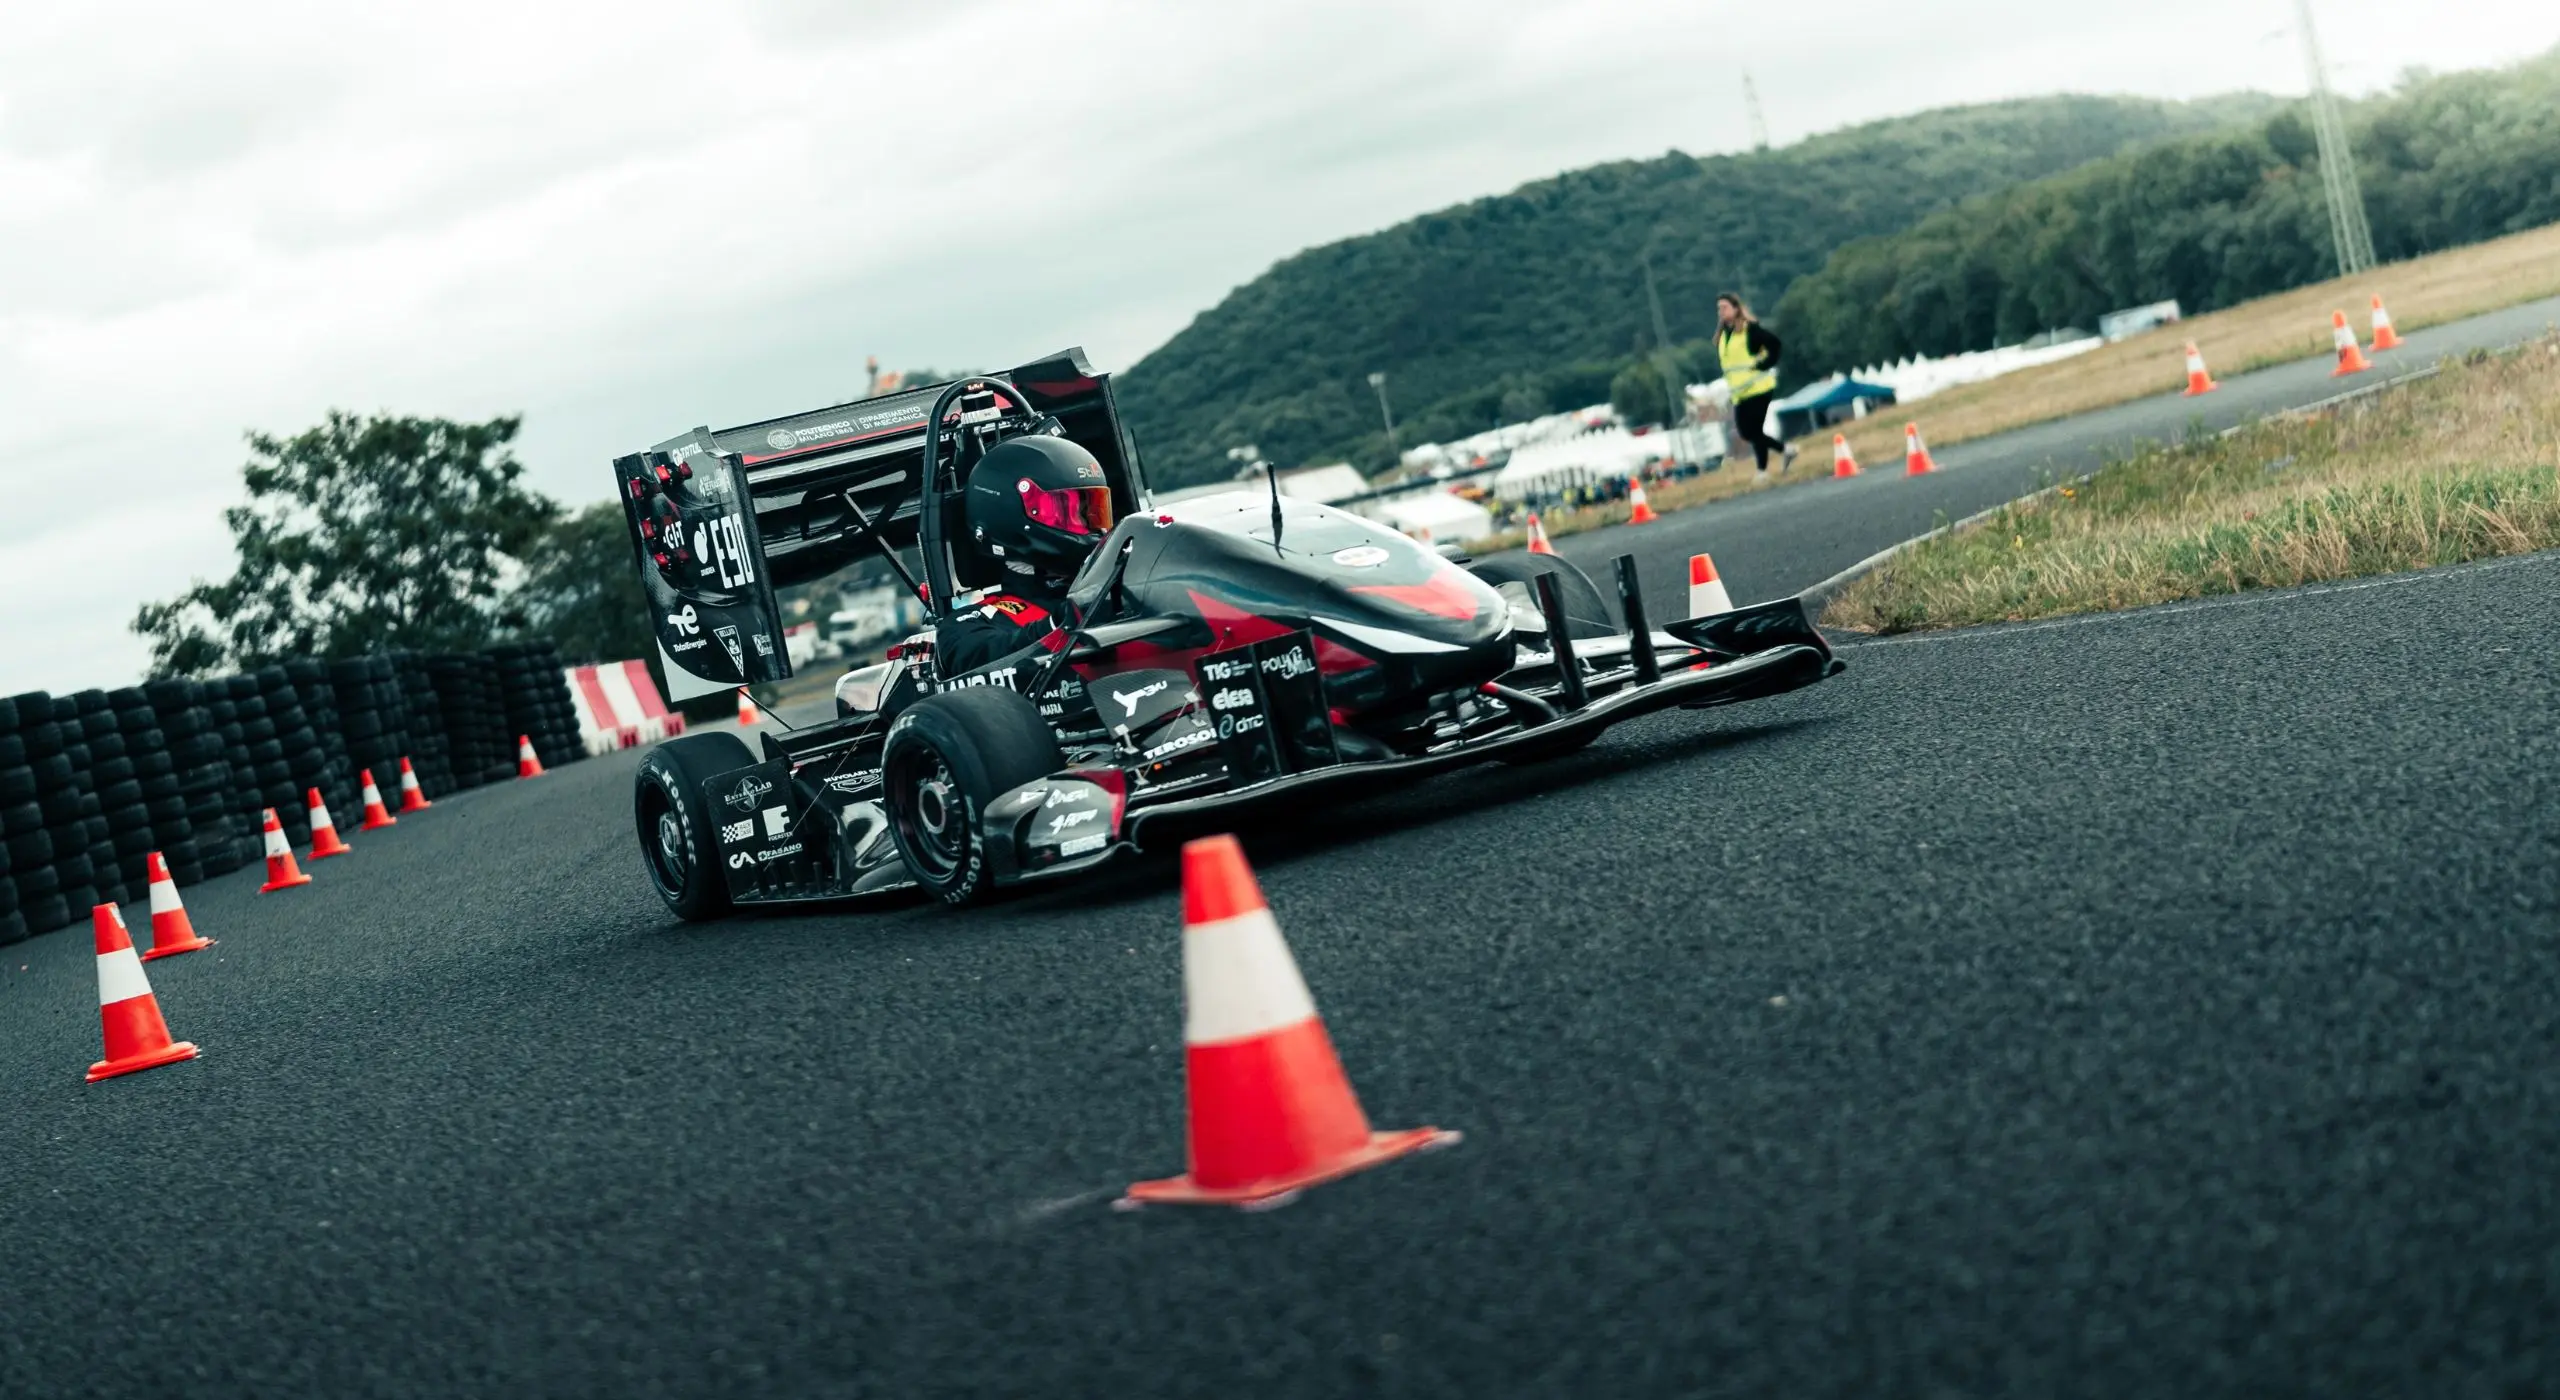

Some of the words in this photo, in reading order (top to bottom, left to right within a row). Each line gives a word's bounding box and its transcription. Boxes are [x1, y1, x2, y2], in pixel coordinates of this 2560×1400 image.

[858, 406, 921, 424] DIPARTIMENTO
[863, 421, 871, 430] DI
[874, 411, 927, 427] MECCANICA
[795, 420, 851, 437] POLITECNICO
[799, 431, 835, 443] MILANO
[710, 512, 755, 589] E90
[673, 638, 708, 653] TotalEnergies
[1203, 661, 1231, 681] TIG
[1143, 727, 1218, 760] TEROSO
[823, 770, 868, 784] NUVOLARI
[766, 843, 803, 858] FASANO
